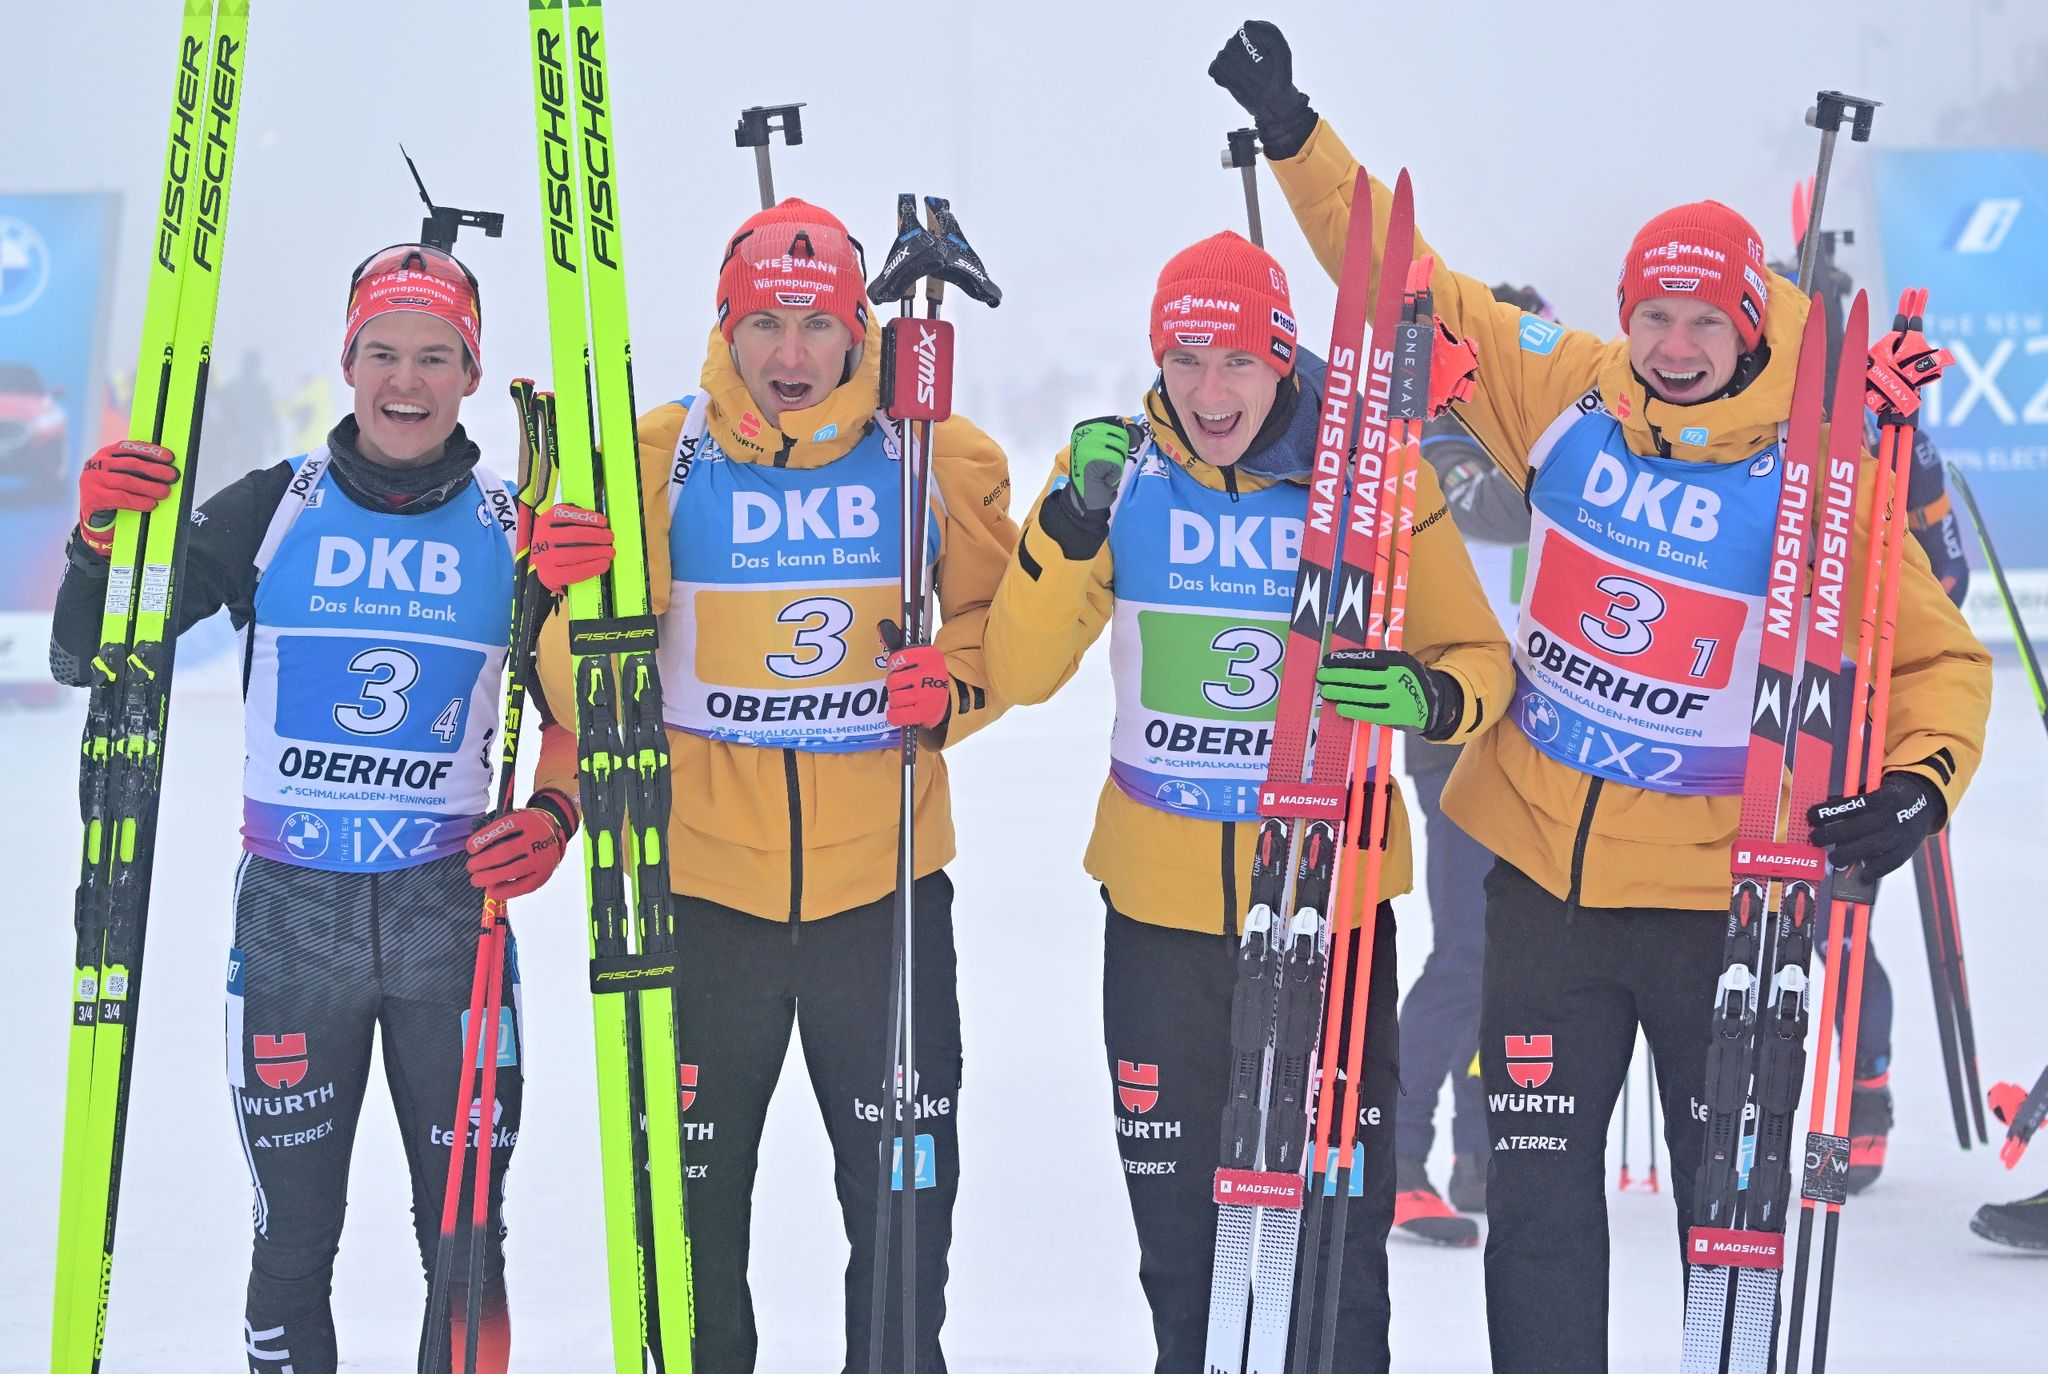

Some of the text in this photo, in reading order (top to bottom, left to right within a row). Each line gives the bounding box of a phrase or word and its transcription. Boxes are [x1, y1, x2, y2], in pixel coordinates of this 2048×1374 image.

[158, 35, 203, 274] FISCHER
[193, 34, 240, 272] FISCHER
[537, 27, 577, 273] FISCHER
[577, 25, 617, 271] FISCHER
[754, 278, 834, 294] Wärmepumpen
[1643, 265, 1721, 280] Wärmepumpen
[369, 285, 454, 304] Wärmepumpen
[1162, 319, 1236, 331] Wärmepumpen
[525, 415, 536, 443] LEKI
[546, 426, 556, 458] LEKI
[1310, 345, 1355, 535] MADSHUS
[1351, 348, 1394, 538] MADSHUS
[119, 441, 164, 458] Roeckl
[290, 459, 324, 500] JOKA
[485, 488, 516, 532] JOKA
[1581, 450, 1722, 543] DKB
[554, 507, 598, 523] Roeckl
[732, 485, 880, 544] DKB
[1169, 508, 1305, 572] DKB
[1577, 506, 1708, 570] Das kann Bank
[1766, 460, 1809, 640] MADSHUS
[1815, 457, 1855, 639] MADSHUS
[313, 535, 462, 595] DKB
[731, 545, 882, 570] Das kann Bank
[1168, 572, 1296, 597] Das kann Ba
[309, 595, 457, 623] Das kann Bank
[1580, 574, 1666, 656] 3
[574, 628, 655, 643] FISCHER
[763, 595, 855, 679] 3
[1202, 626, 1284, 712] 3
[1331, 650, 1376, 660] Roeckl
[1688, 637, 1720, 678] 1
[1527, 630, 1710, 719] OBERHOF
[333, 646, 421, 737] 3
[1536, 669, 1703, 739] SCHMALKALDEN-MEININGEN
[431, 697, 463, 744] 4
[503, 684, 523, 764] LEKI
[728, 719, 891, 739] SCHMALKALDEN-MEININGE
[1145, 719, 1273, 756] OBERH
[278, 746, 453, 790] OBERHOF
[1578, 724, 1683, 787] iX2
[294, 785, 446, 806] SCHMALKALDEN-MEININGEN
[1279, 795, 1339, 807] MADSHUS
[1818, 797, 1866, 819] Roeckl
[1897, 793, 1928, 824] Roeckl
[353, 817, 441, 863] iX2
[472, 819, 515, 849] Roeckl
[1755, 854, 1818, 868] MADSHUS
[596, 965, 675, 982] FISCHER
[78, 1005, 93, 1022] 3/4
[104, 1002, 121, 1020] 3/4
[243, 1082, 335, 1117] WÜRTH
[1488, 1093, 1575, 1115] WÜRTH
[271, 1119, 334, 1148] TERREX
[1509, 1136, 1567, 1152] TERREX
[1124, 1159, 1177, 1175] TERREX
[1236, 1183, 1295, 1196] MADSHUS
[1713, 1242, 1777, 1255] MADSHUS
